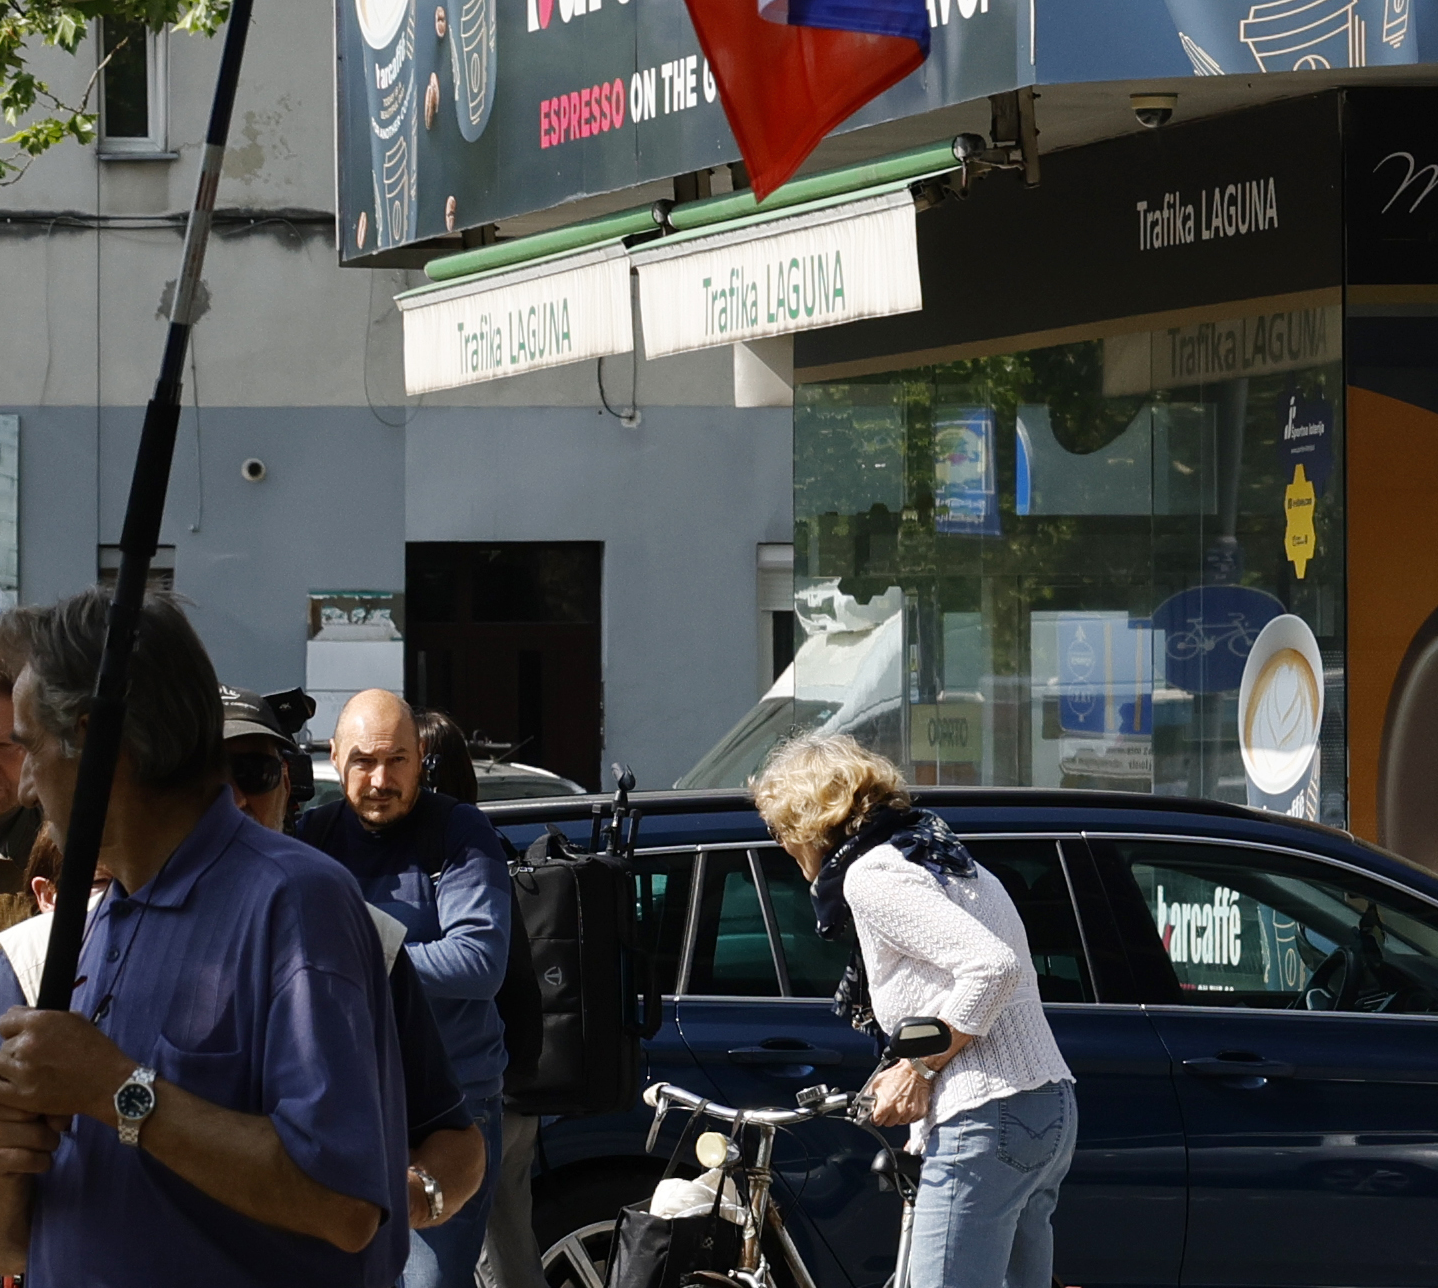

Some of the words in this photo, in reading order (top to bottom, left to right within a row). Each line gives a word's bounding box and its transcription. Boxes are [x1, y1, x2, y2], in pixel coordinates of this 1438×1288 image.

[540, 77, 626, 150] ESPRESSO
[630, 68, 656, 124] ON
[661, 55, 697, 113] THE
[703, 56, 717, 104] G
[1137, 193, 1194, 251] Trafika
[1201, 177, 1278, 241] LAGUNA
[702, 267, 758, 334] Trafika
[766, 251, 845, 325] LAGUNA
[457, 317, 502, 376] Trafika
[508, 297, 571, 367] LAGUNA
[1157, 885, 1241, 966] barcaffé
